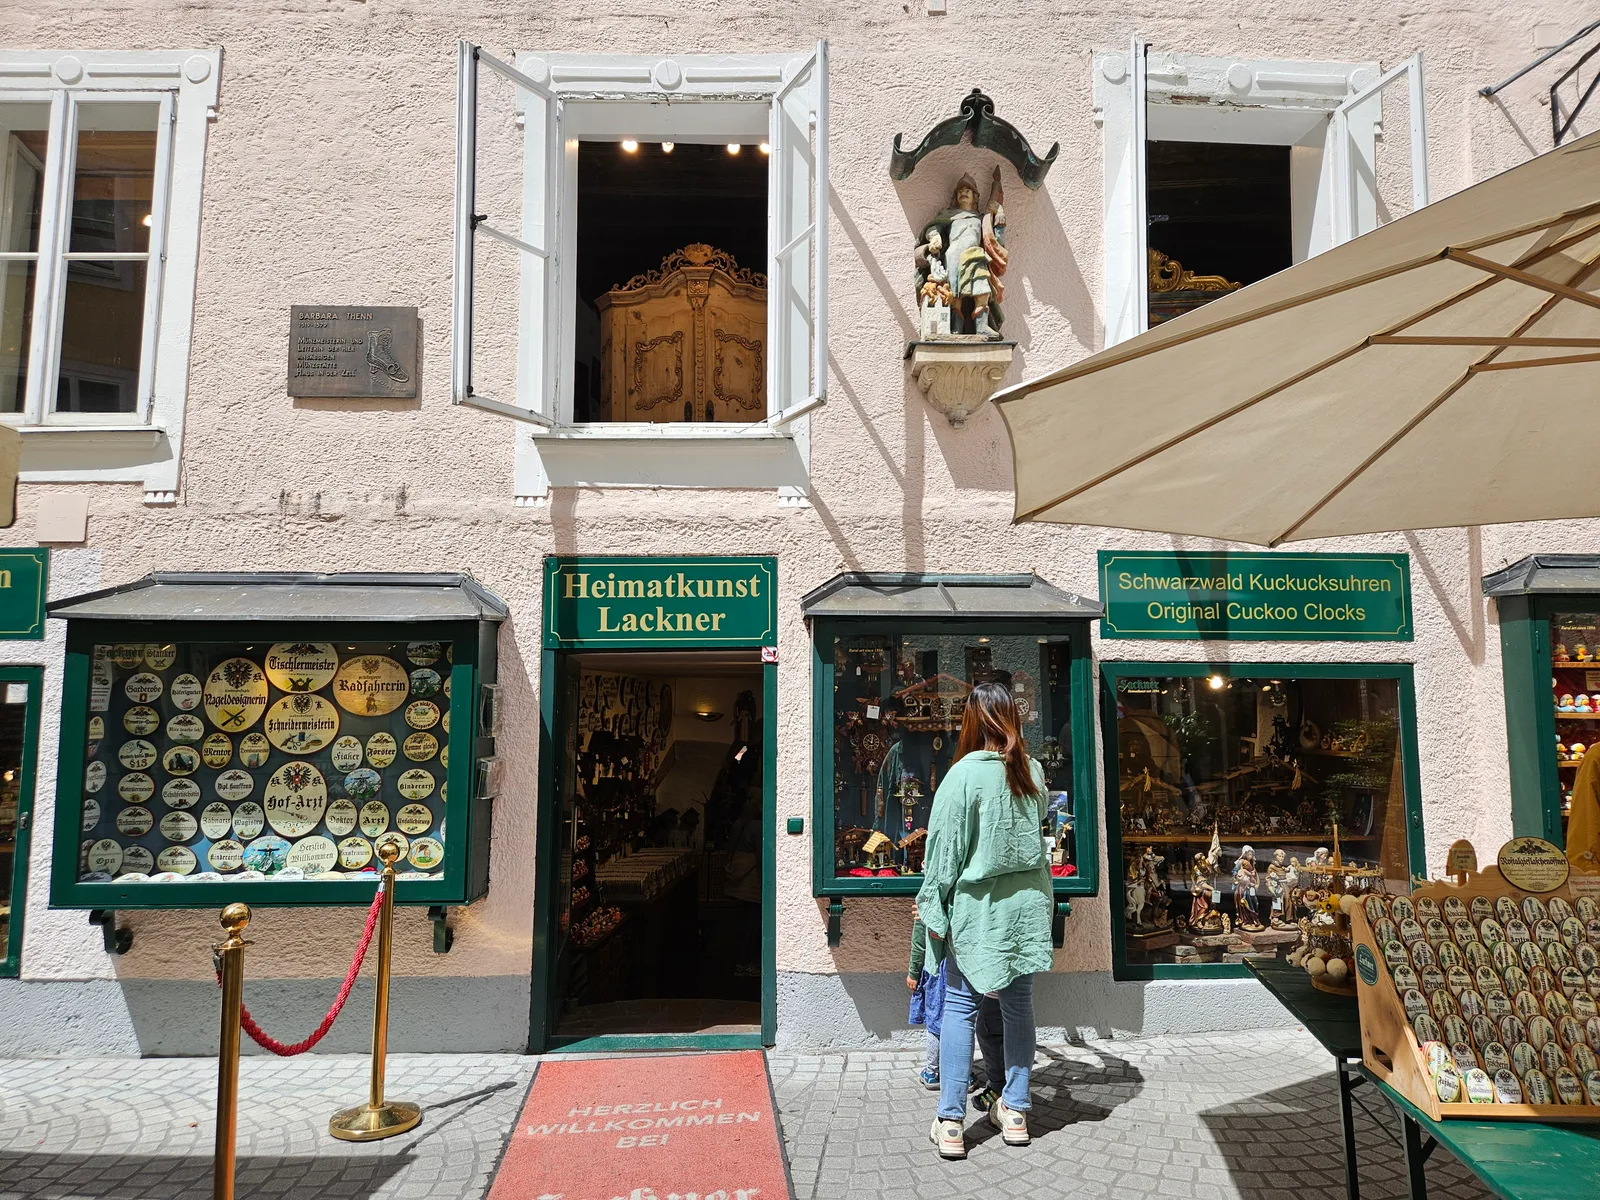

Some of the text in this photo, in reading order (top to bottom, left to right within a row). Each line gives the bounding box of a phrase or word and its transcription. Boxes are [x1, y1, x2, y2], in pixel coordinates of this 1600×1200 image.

[299, 312, 373, 320] BARBARA THENN
[563, 572, 760, 599] Heimatkunst
[1118, 572, 1392, 592] Schwarzwald Kuckucksuhren
[597, 606, 726, 632] Lackner
[1147, 602, 1366, 624] Original Cuckoo Clocks
[268, 655, 336, 672] Tischlermeister
[126, 684, 162, 693] Garderobe
[339, 679, 406, 694] Radfahrerin
[205, 693, 266, 709] Nageldesignerin
[268, 718, 335, 733] Schneidermeisterin
[203, 747, 231, 756] Mentor
[333, 751, 360, 761] Fiaker
[366, 747, 396, 757] Förster
[399, 783, 434, 791] Kinderarzt
[267, 794, 323, 811] Hof-Arzt
[202, 816, 231, 825] Zahnarzt
[328, 815, 354, 824] Doktor
[362, 816, 385, 826] Arzt
[298, 843, 327, 852] Herzlich
[96, 857, 116, 866] Opa
[291, 853, 334, 863] Willkommen
[567, 1098, 724, 1117] HERZLICH
[526, 1111, 760, 1136] WILLKOMMEN
[616, 1133, 669, 1149] BEI
